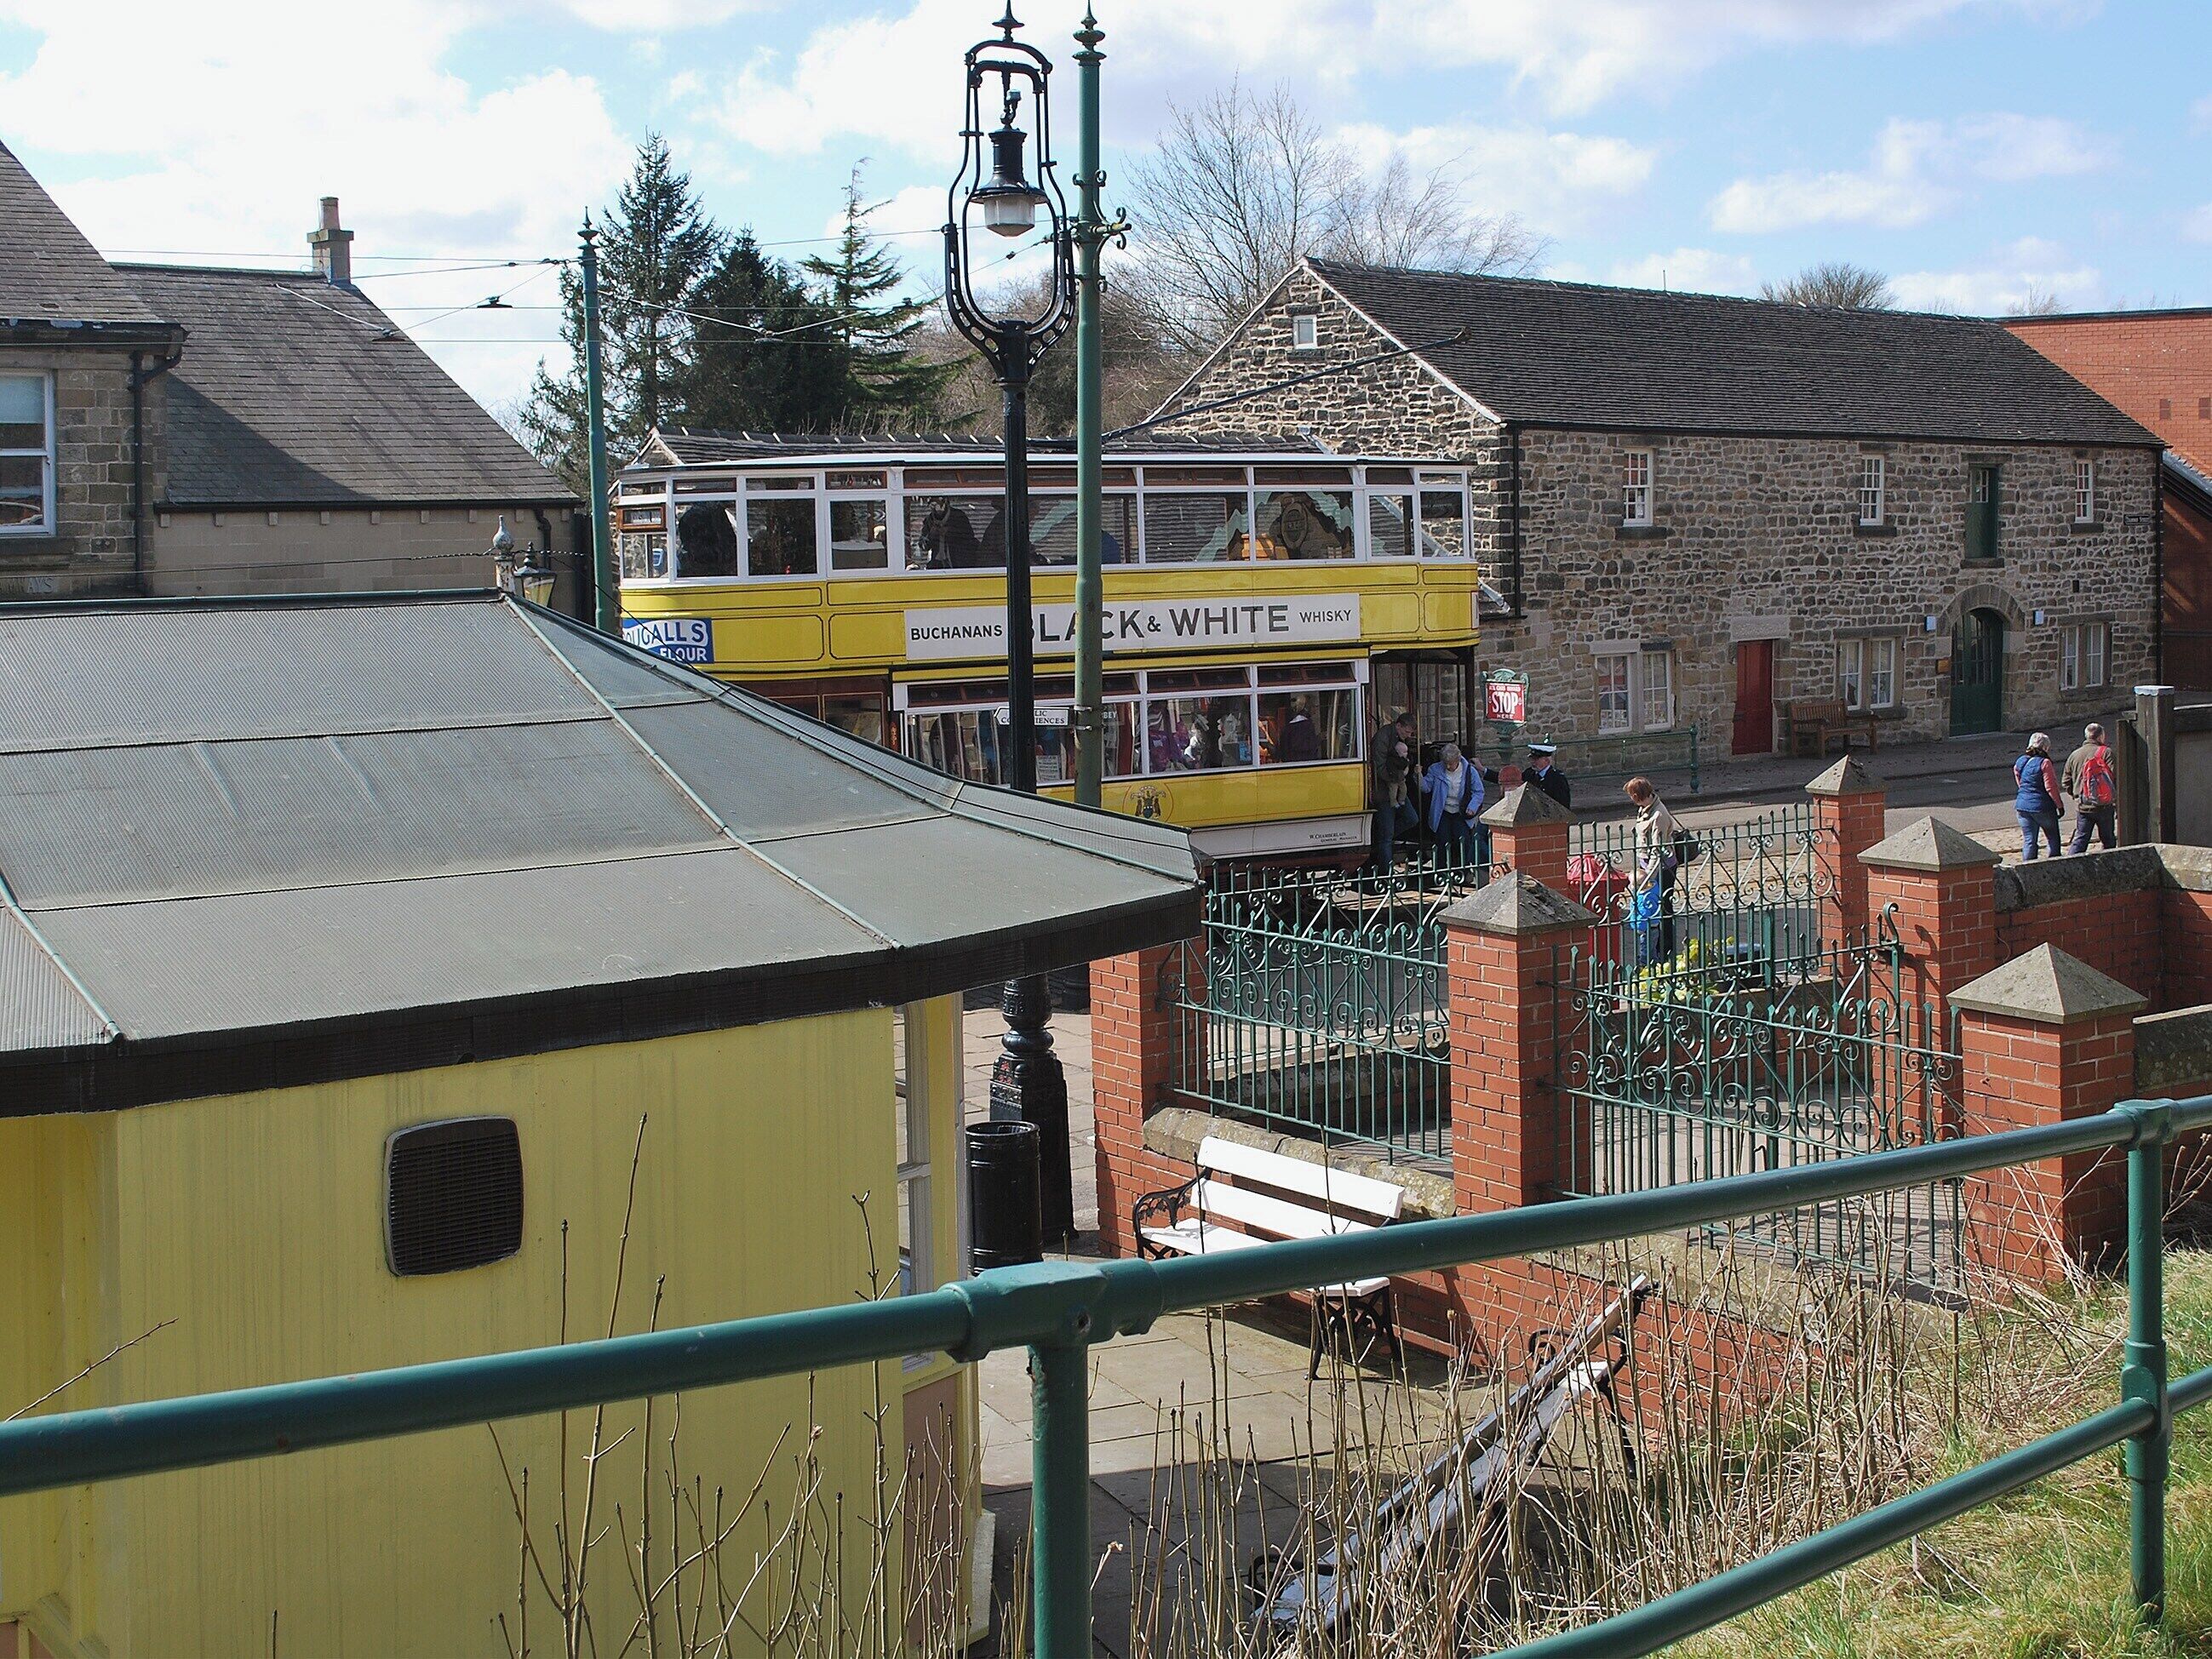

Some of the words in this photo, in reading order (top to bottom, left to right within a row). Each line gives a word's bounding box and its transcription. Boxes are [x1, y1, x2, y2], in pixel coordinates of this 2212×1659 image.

[622, 622, 704, 646] OUGALLS
[911, 625, 1003, 640] BUCHANANS
[1030, 609, 1144, 642] LCK
[1147, 615, 1160, 632] &
[1169, 604, 1289, 637] WHITE
[1299, 609, 1351, 623] WHISKY
[660, 647, 708, 662] FLOUR
[1492, 691, 1519, 714] STOP
